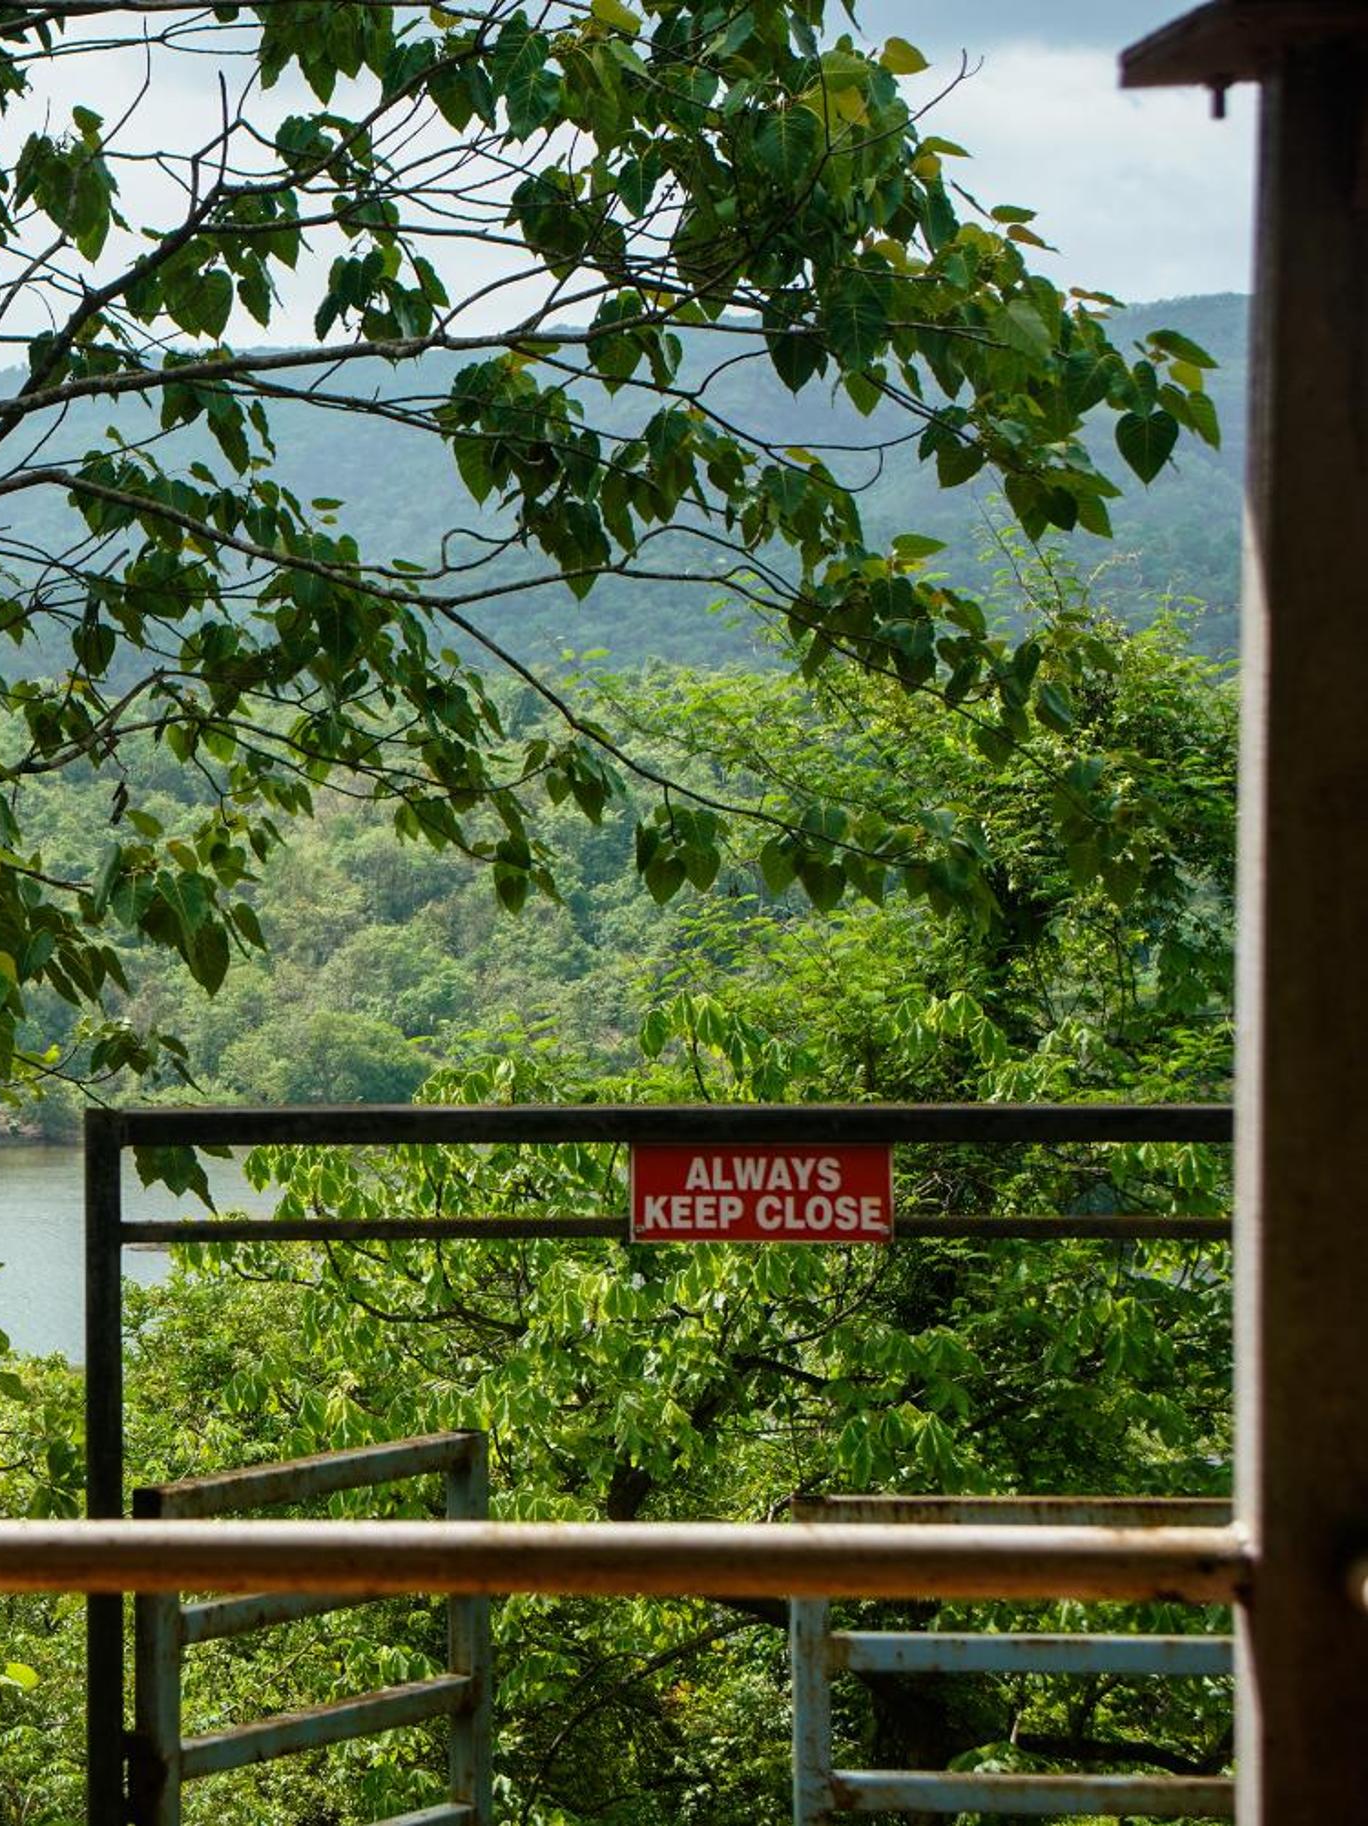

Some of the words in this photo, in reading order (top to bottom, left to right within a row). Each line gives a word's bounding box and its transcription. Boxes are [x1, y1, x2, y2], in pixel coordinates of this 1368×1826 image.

[685, 1157, 842, 1191] ALWAYS
[644, 1195, 744, 1230] KEEP
[755, 1195, 884, 1231] CLOSE
